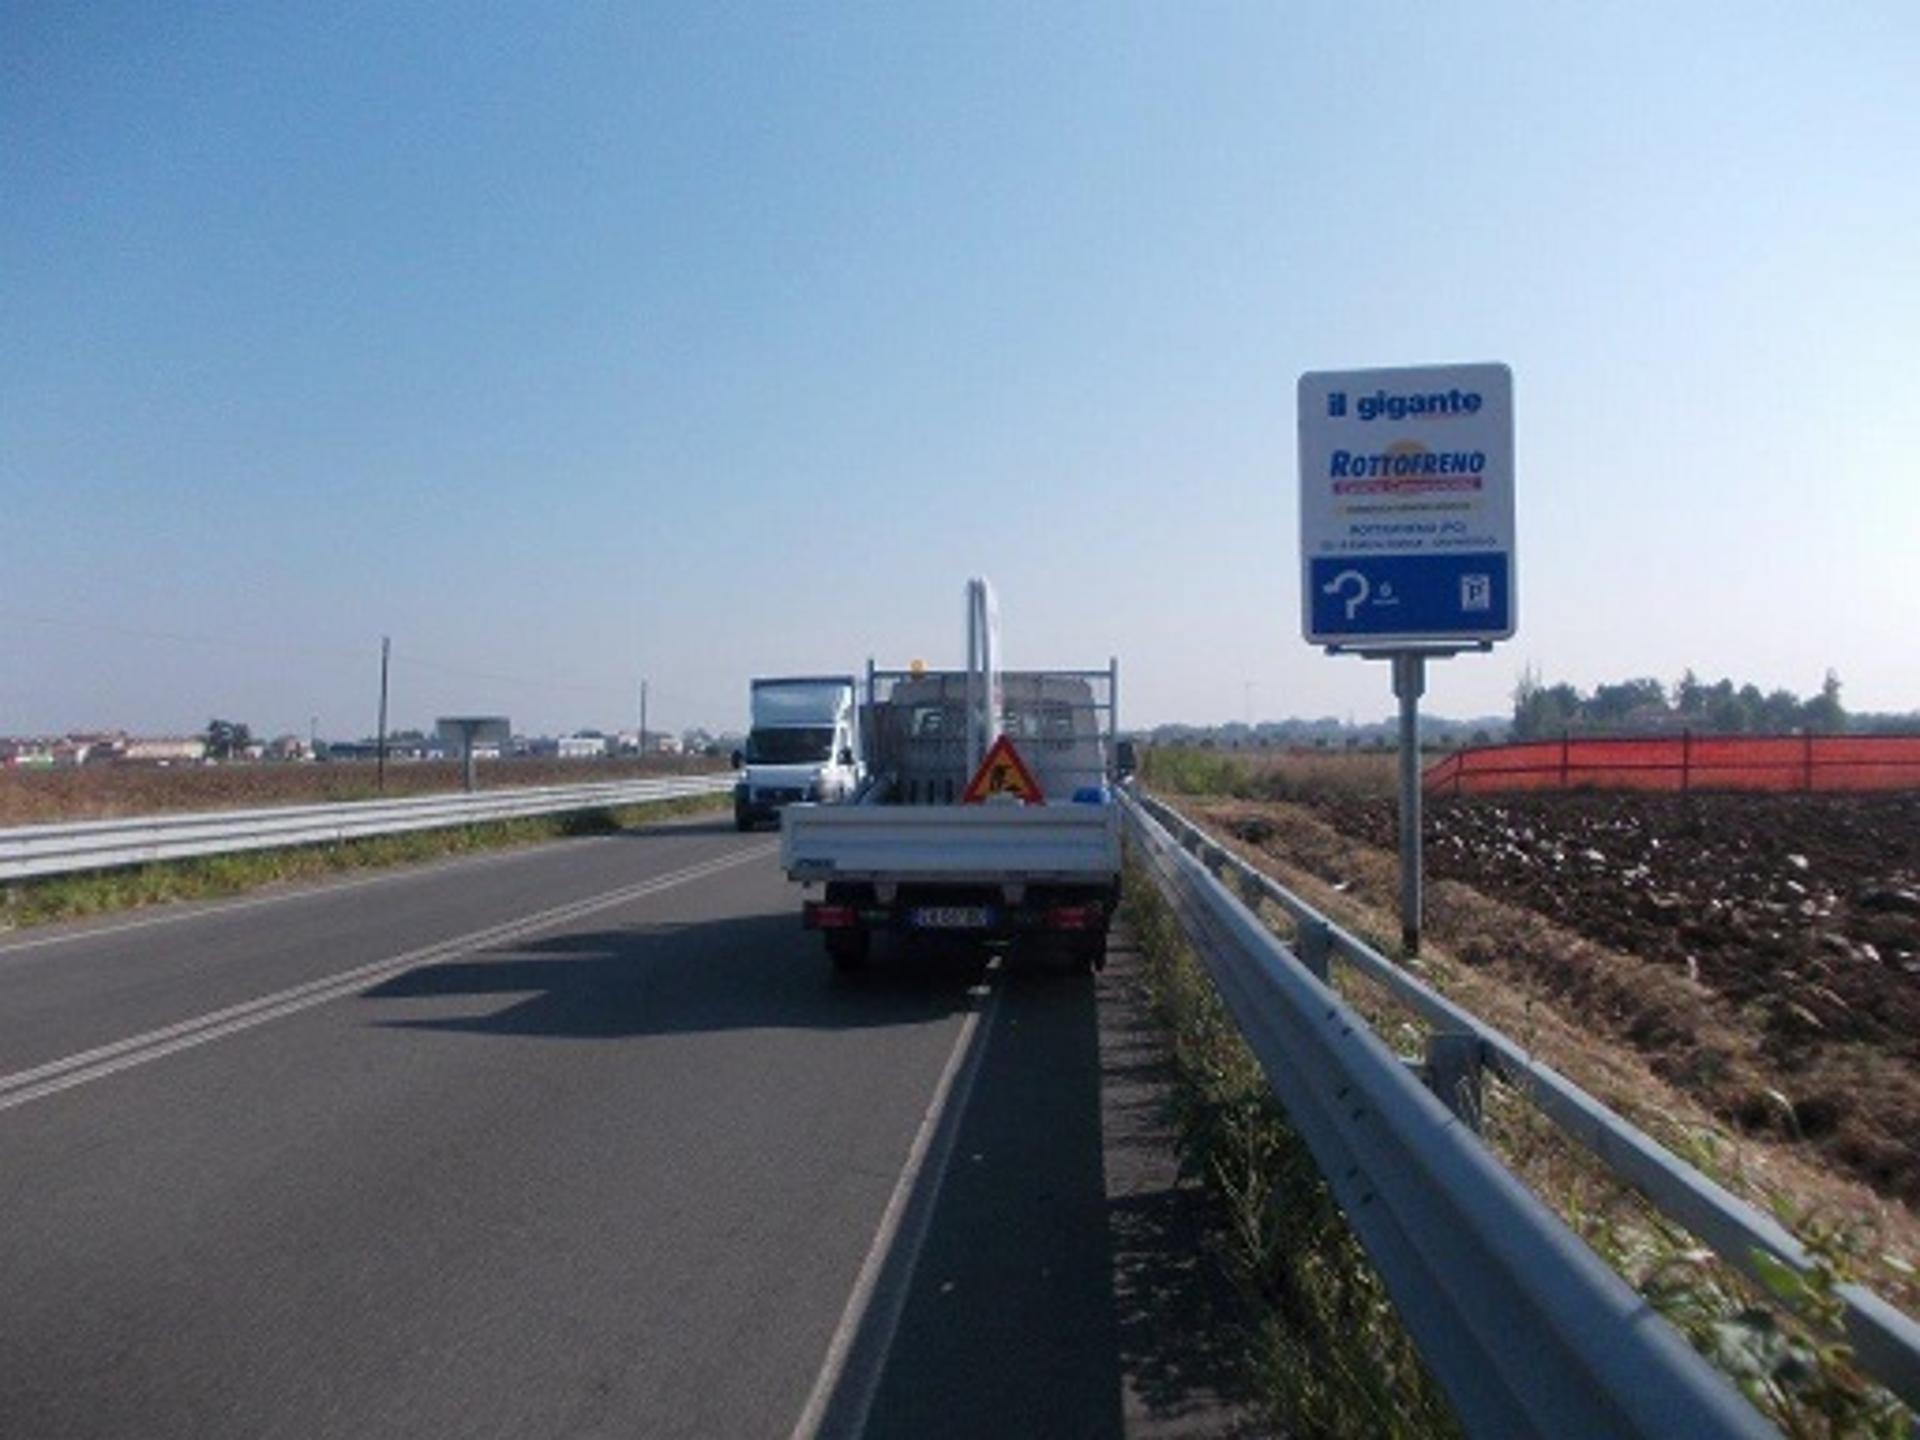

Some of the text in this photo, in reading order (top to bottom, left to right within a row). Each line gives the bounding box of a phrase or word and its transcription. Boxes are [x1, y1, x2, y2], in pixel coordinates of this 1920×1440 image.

[1327, 388, 1483, 421] il gigante
[1330, 448, 1487, 479] ROTTOFRENO
